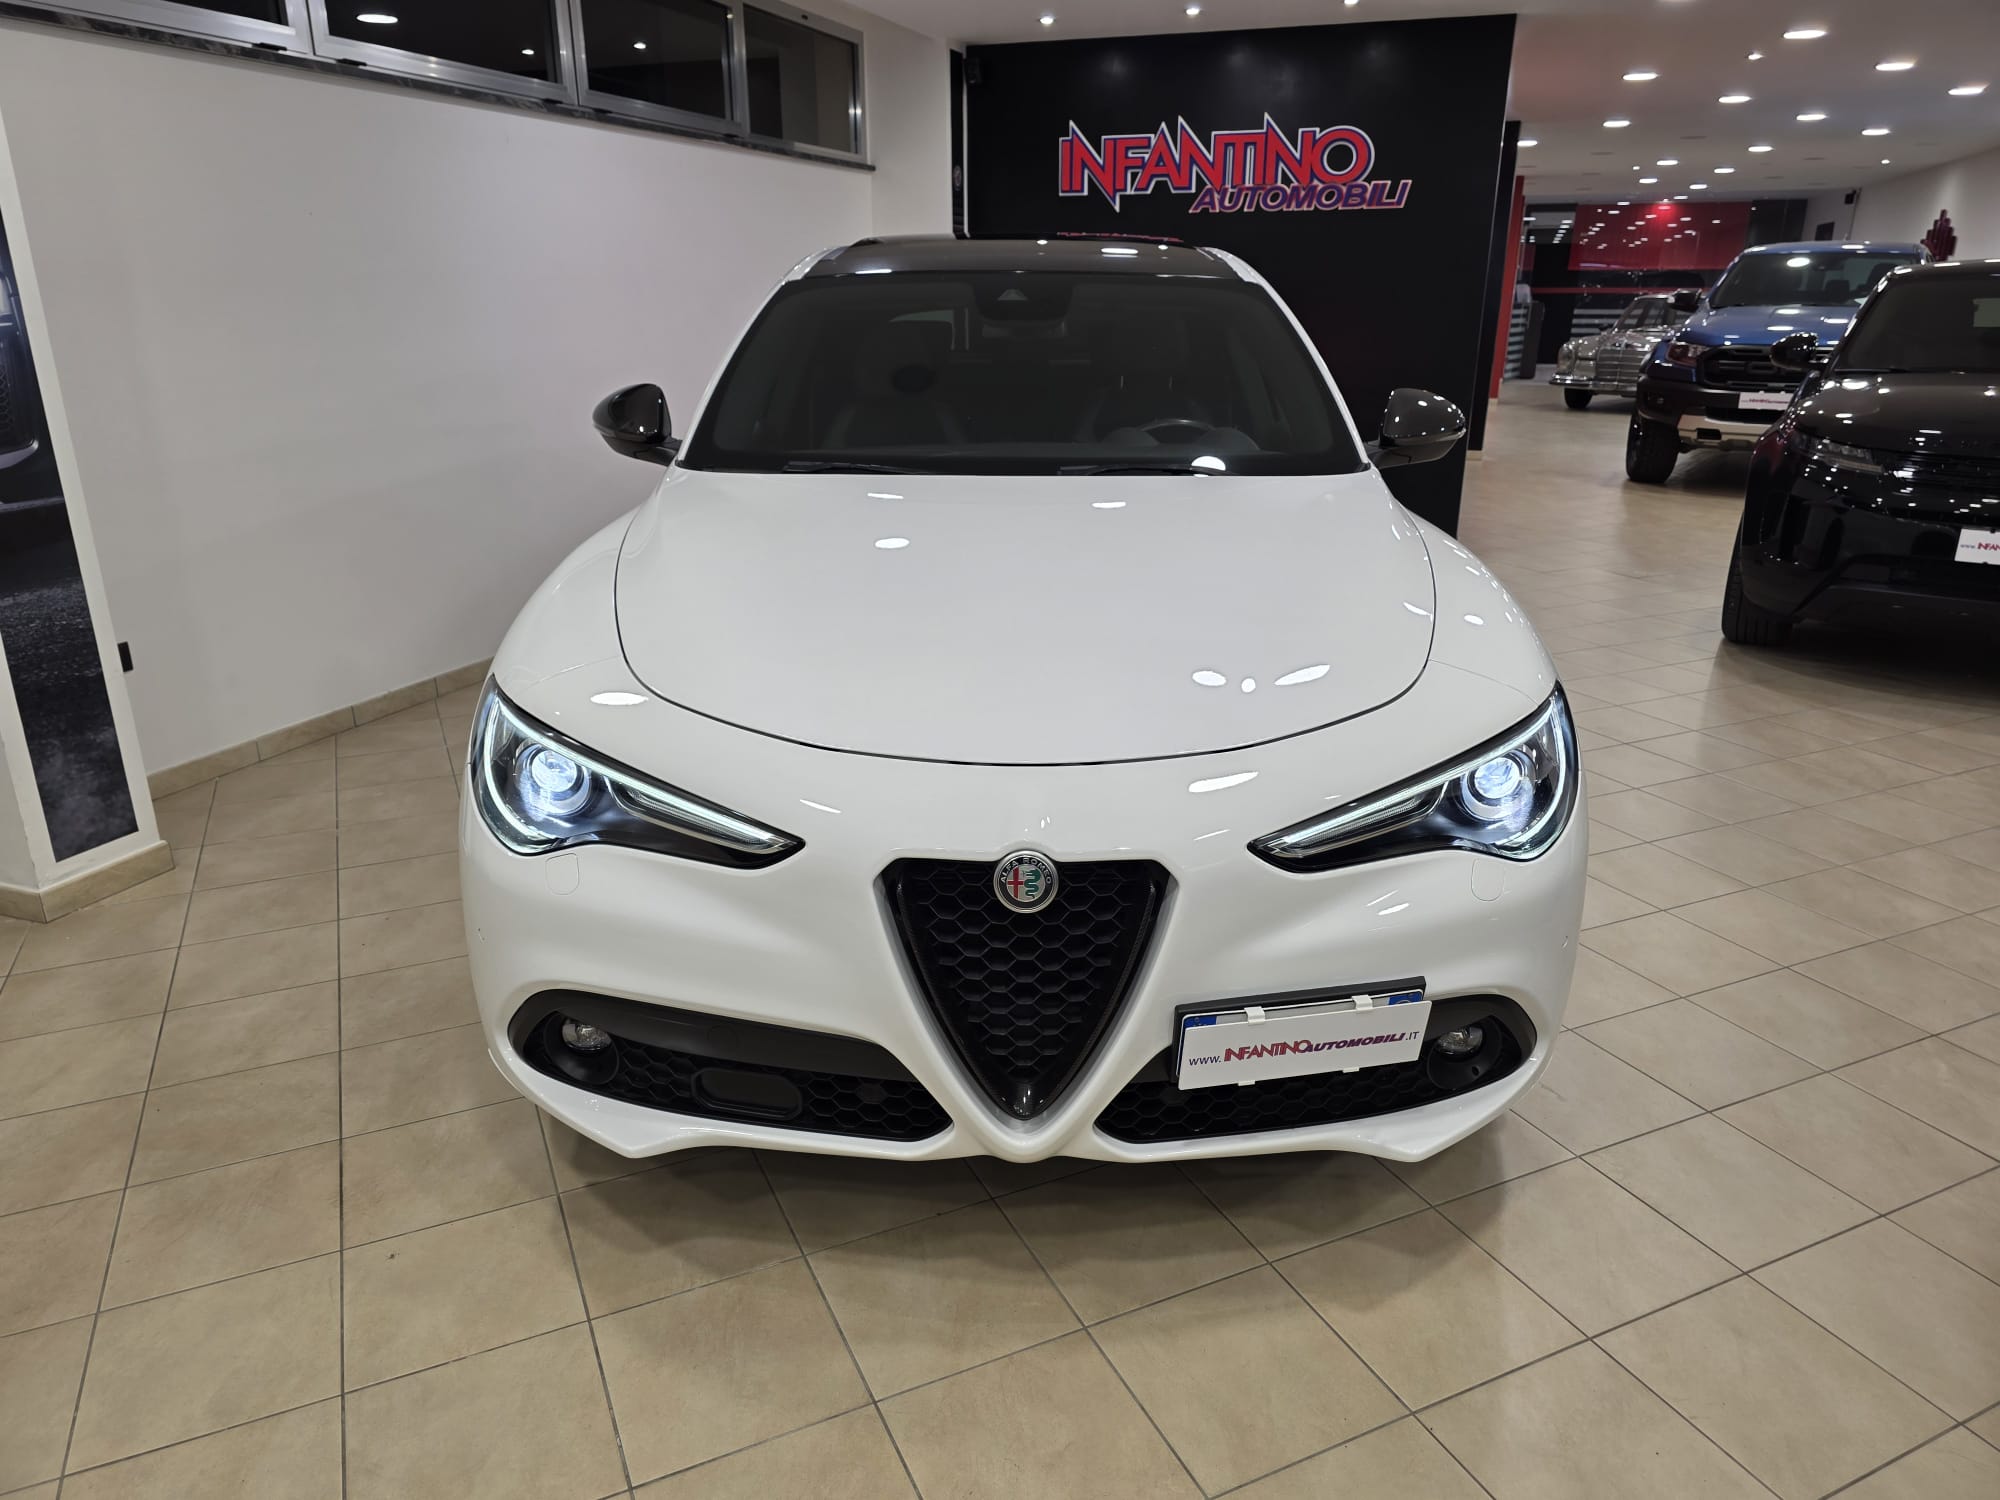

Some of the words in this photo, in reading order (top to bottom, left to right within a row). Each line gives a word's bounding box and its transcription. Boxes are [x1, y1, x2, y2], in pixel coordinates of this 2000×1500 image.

[1059, 112, 1375, 212] INFANTINO
[1189, 180, 1413, 214] AUTOMOBILI
[1000, 860, 1019, 884] ALFA
[1022, 857, 1052, 884] ROMEO
